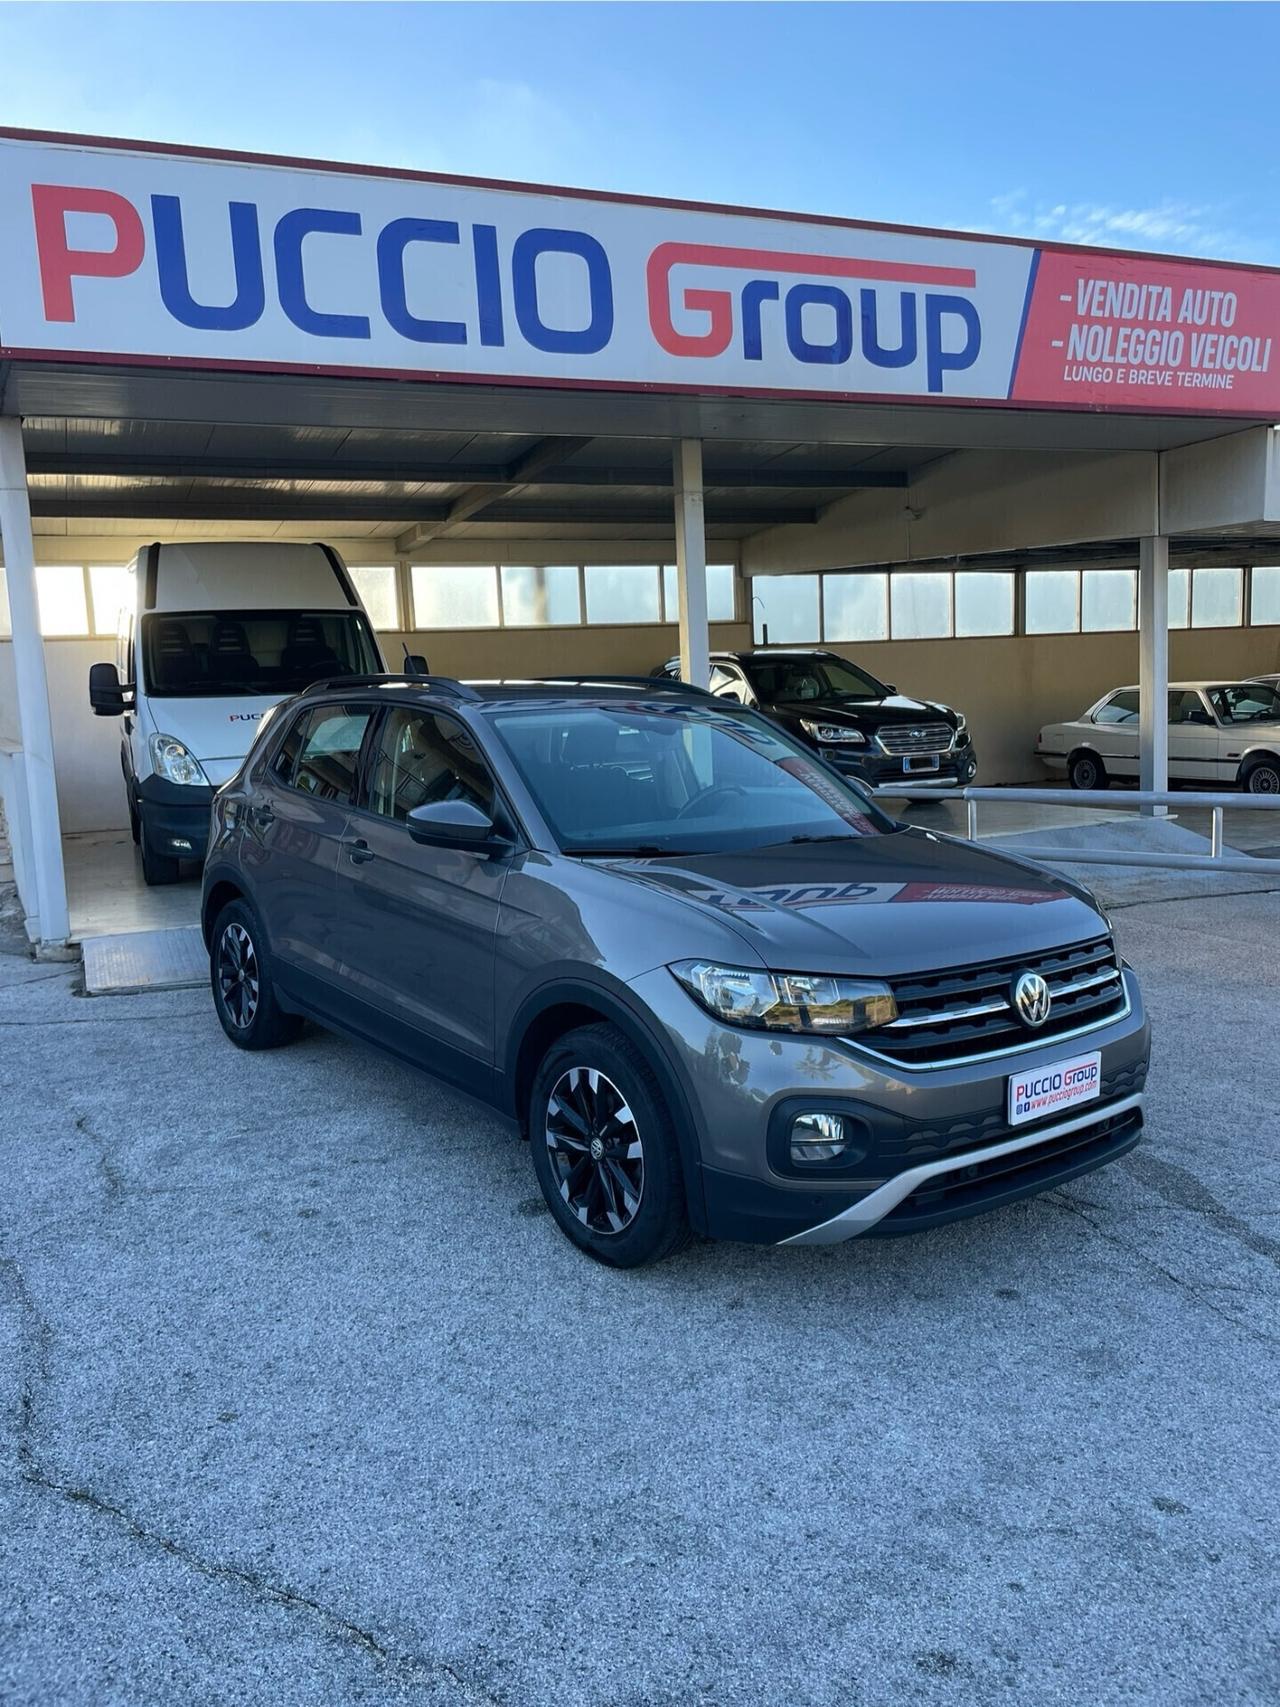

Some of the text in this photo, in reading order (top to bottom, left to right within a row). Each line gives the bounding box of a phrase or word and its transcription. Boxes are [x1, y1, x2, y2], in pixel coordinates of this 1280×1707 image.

[31, 184, 615, 355] PUCCIO
[1077, 278, 1172, 322] VENDITA
[1177, 288, 1238, 328] AUTO
[1066, 323, 1185, 368] NOLEGGIO
[1190, 332, 1272, 373] VEICOLI
[1063, 365, 1235, 389] LUNGO E BREVE TERMINE
[1016, 1074, 1062, 1102] PUCCIO
